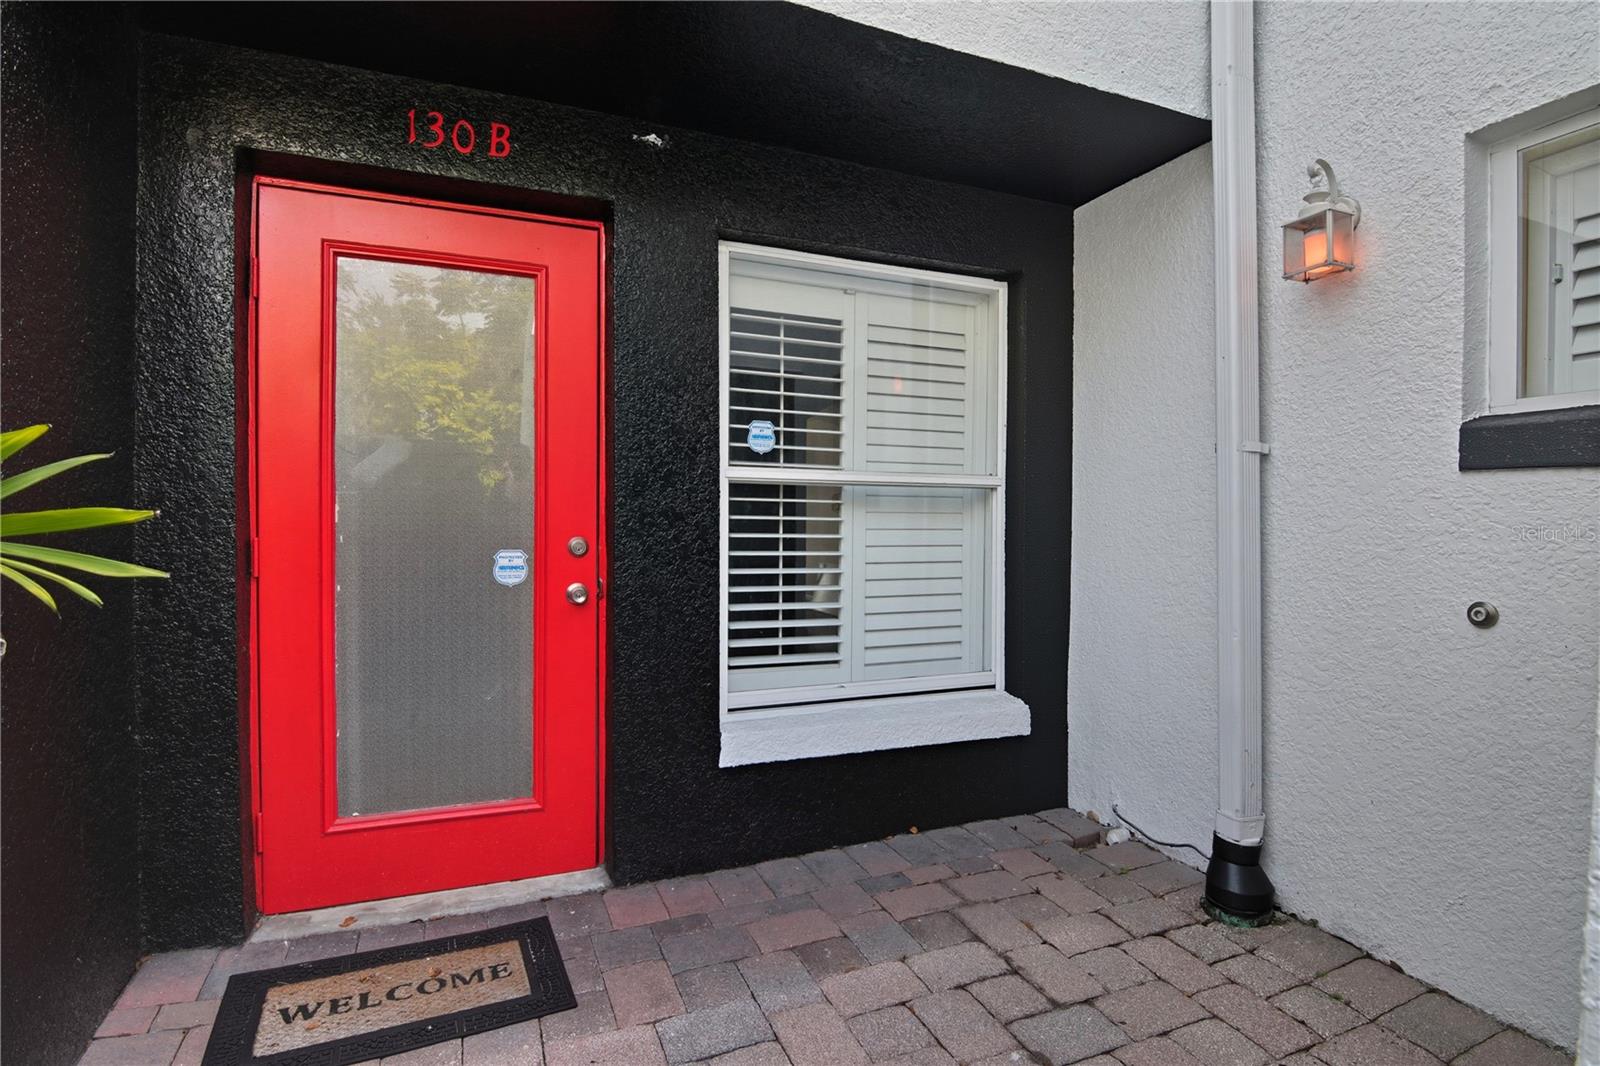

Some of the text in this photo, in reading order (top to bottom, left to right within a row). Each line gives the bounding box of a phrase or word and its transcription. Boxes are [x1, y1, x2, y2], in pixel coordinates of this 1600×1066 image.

[407, 108, 511, 158] 130 B
[277, 962, 513, 1025] WELCOME
